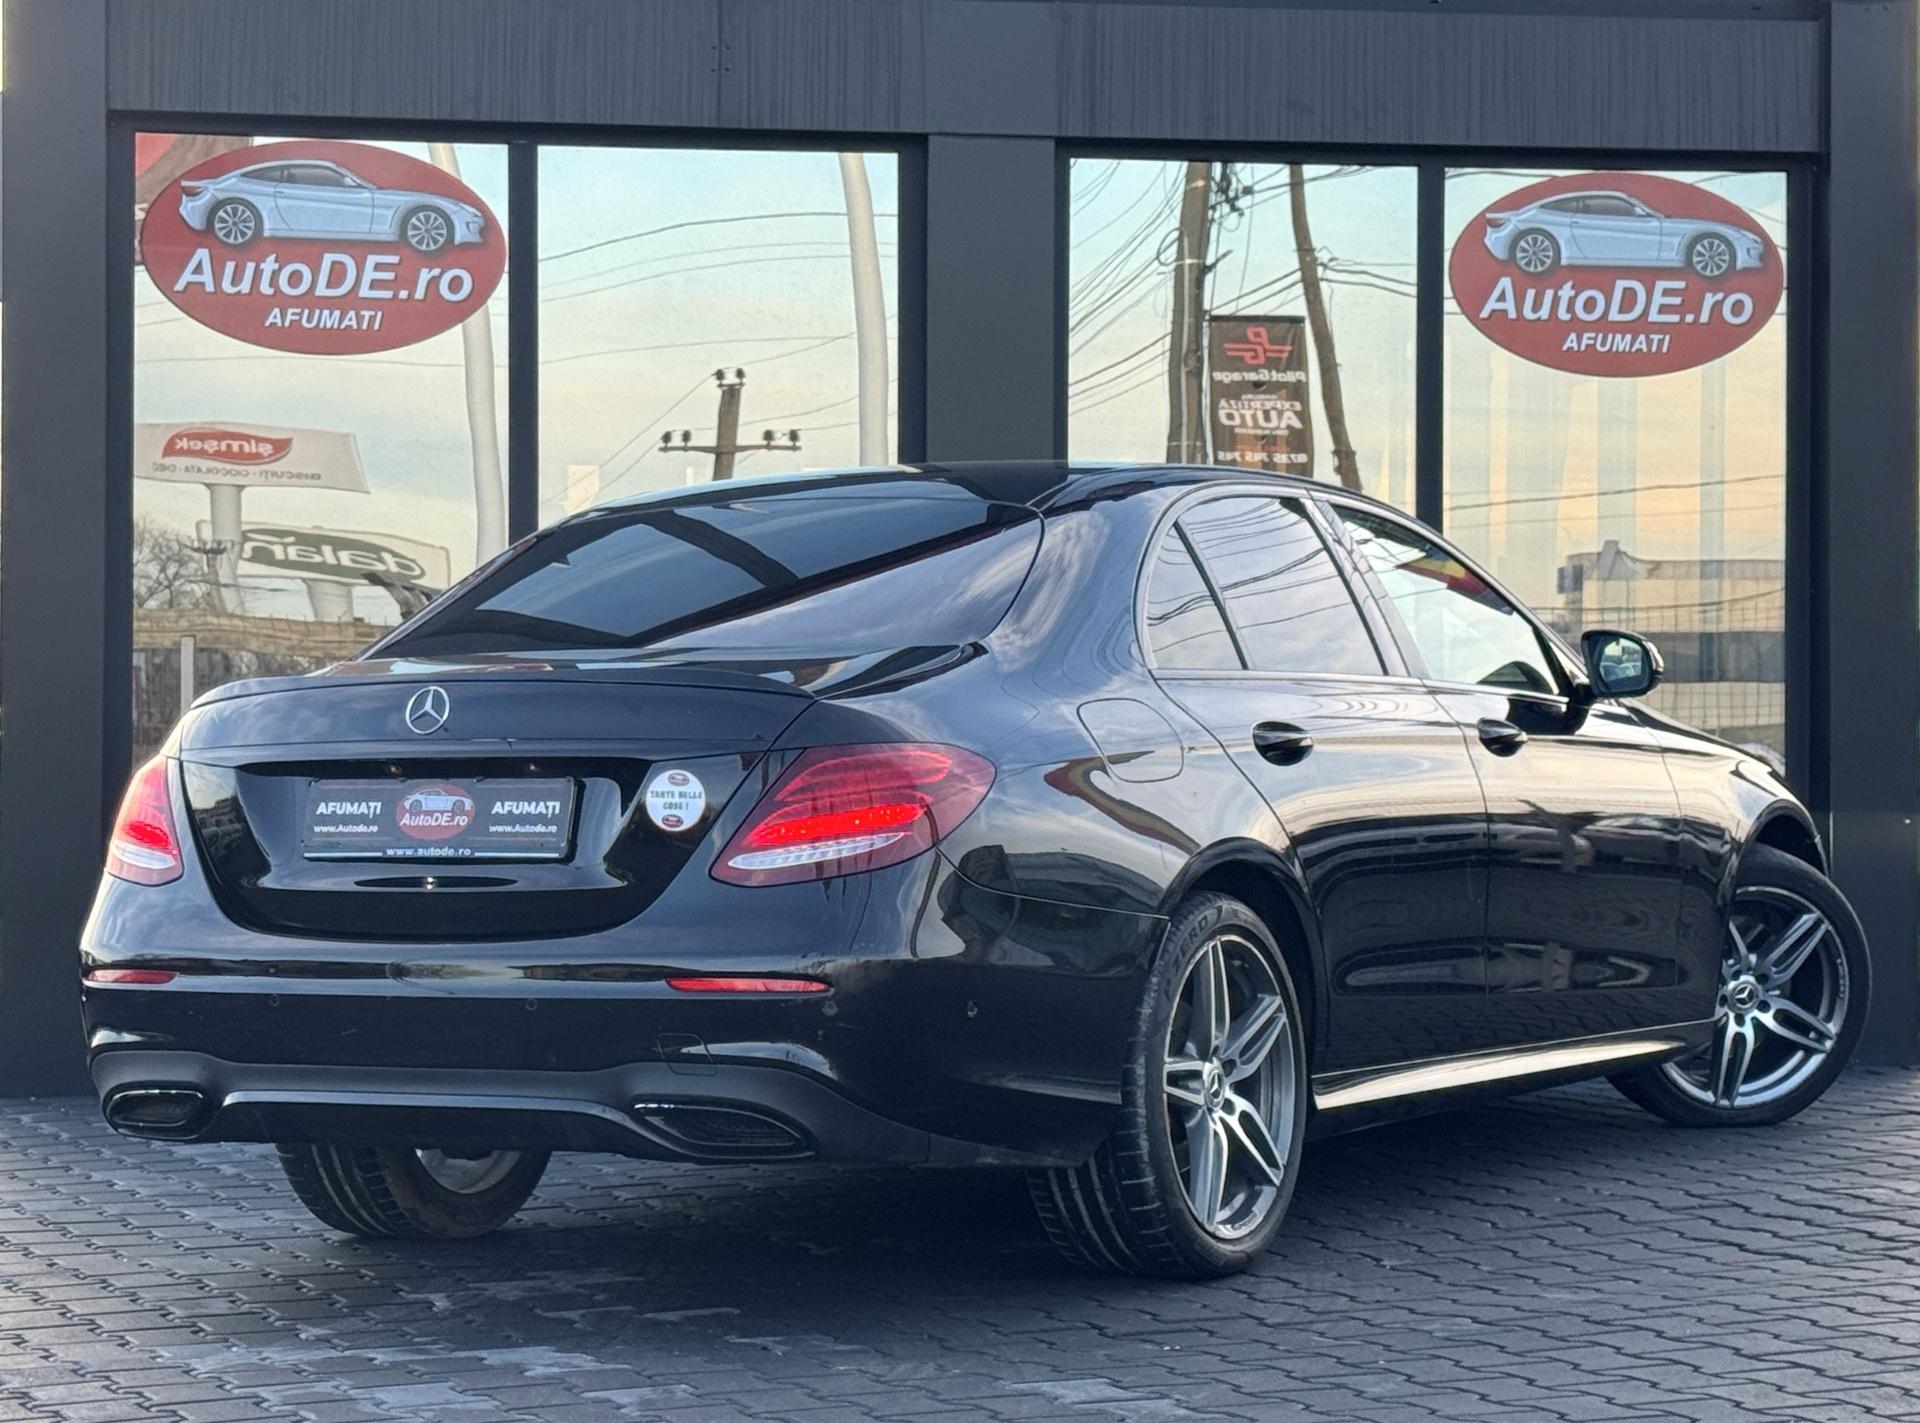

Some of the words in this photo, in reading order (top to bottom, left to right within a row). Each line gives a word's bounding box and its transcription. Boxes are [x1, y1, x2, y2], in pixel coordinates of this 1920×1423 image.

[174, 247, 474, 303] AutoDE.ro
[1480, 276, 1754, 326] AutoDE.ro
[264, 307, 384, 331] AFUMATI
[1561, 333, 1672, 353] AFUMATI
[313, 823, 379, 833] www.Autode.ro
[400, 812, 468, 827] AutoDE.ro
[489, 823, 558, 833] www.Autode.ro
[386, 846, 472, 857] www.autode.ro
